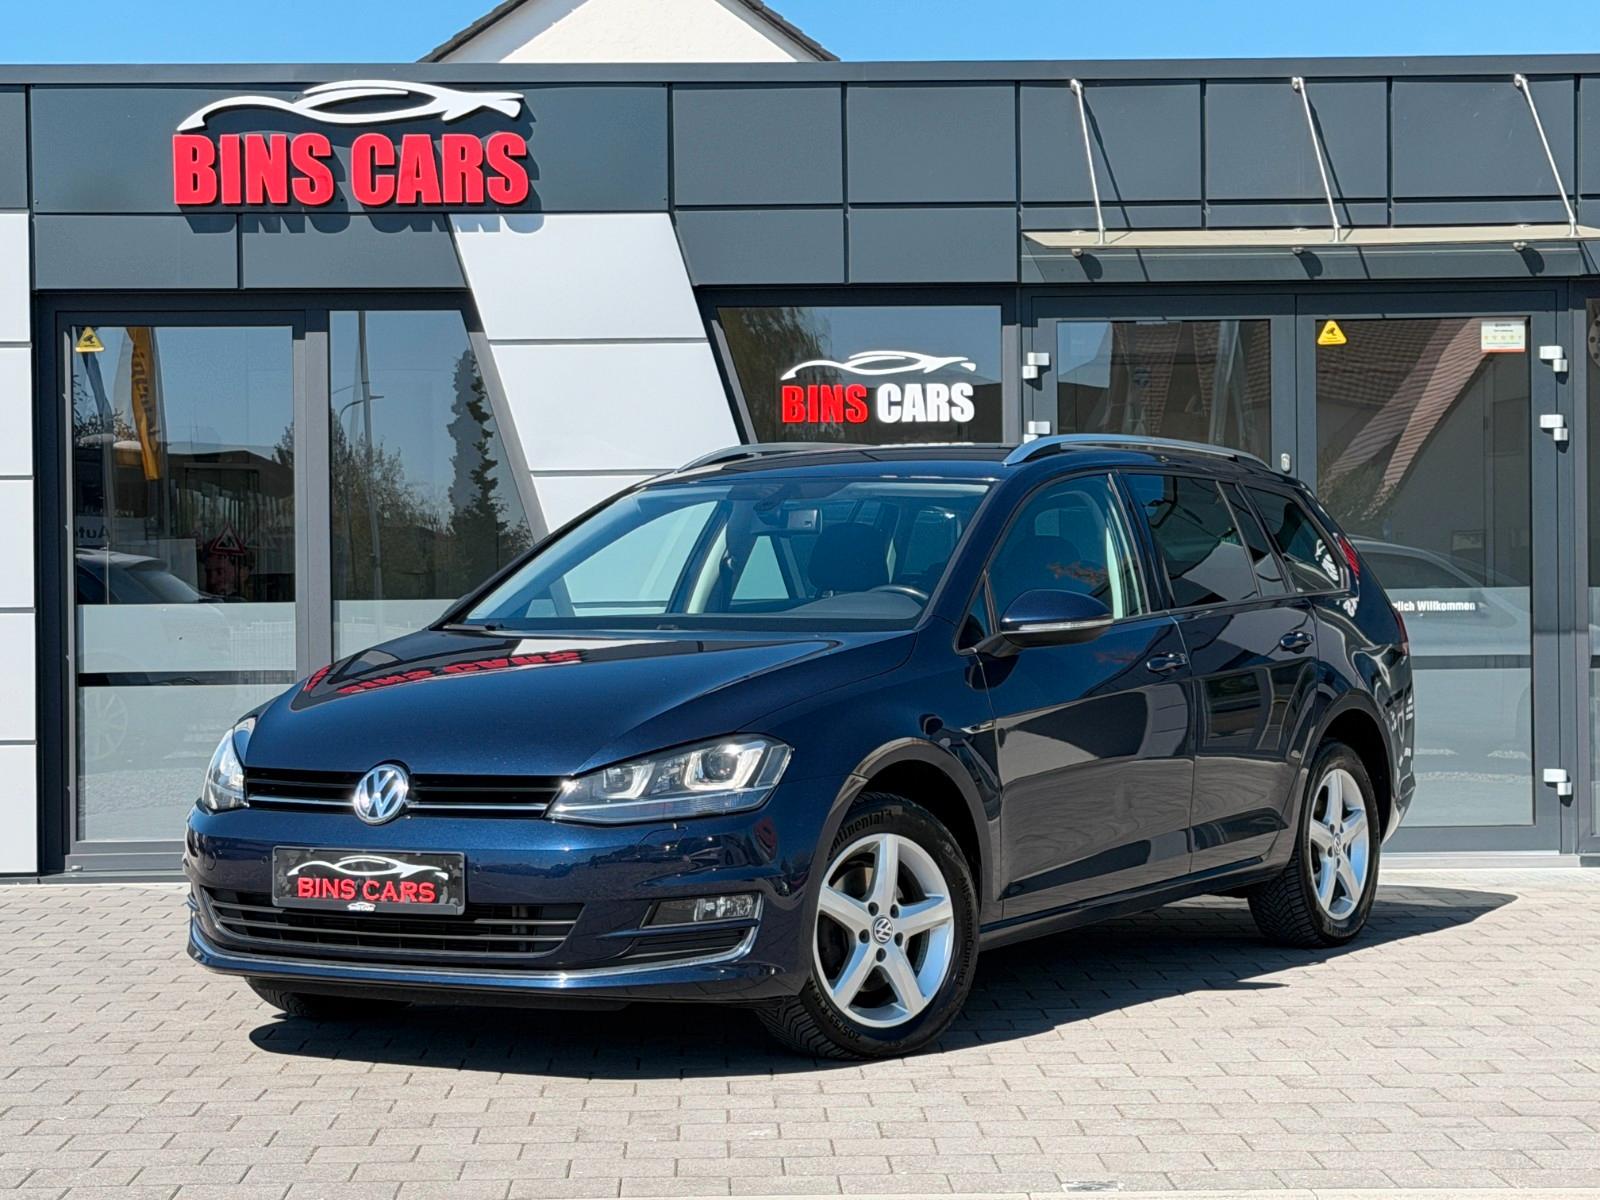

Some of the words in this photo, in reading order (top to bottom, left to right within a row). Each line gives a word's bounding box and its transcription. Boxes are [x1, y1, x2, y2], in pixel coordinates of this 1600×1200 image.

[172, 133, 334, 205] BINS
[350, 132, 530, 205] CARS
[781, 384, 869, 424] BINS
[876, 382, 976, 424] CARS
[1416, 600, 1476, 611] Willkommen
[297, 877, 357, 901] BINS
[362, 880, 437, 904] CARS
